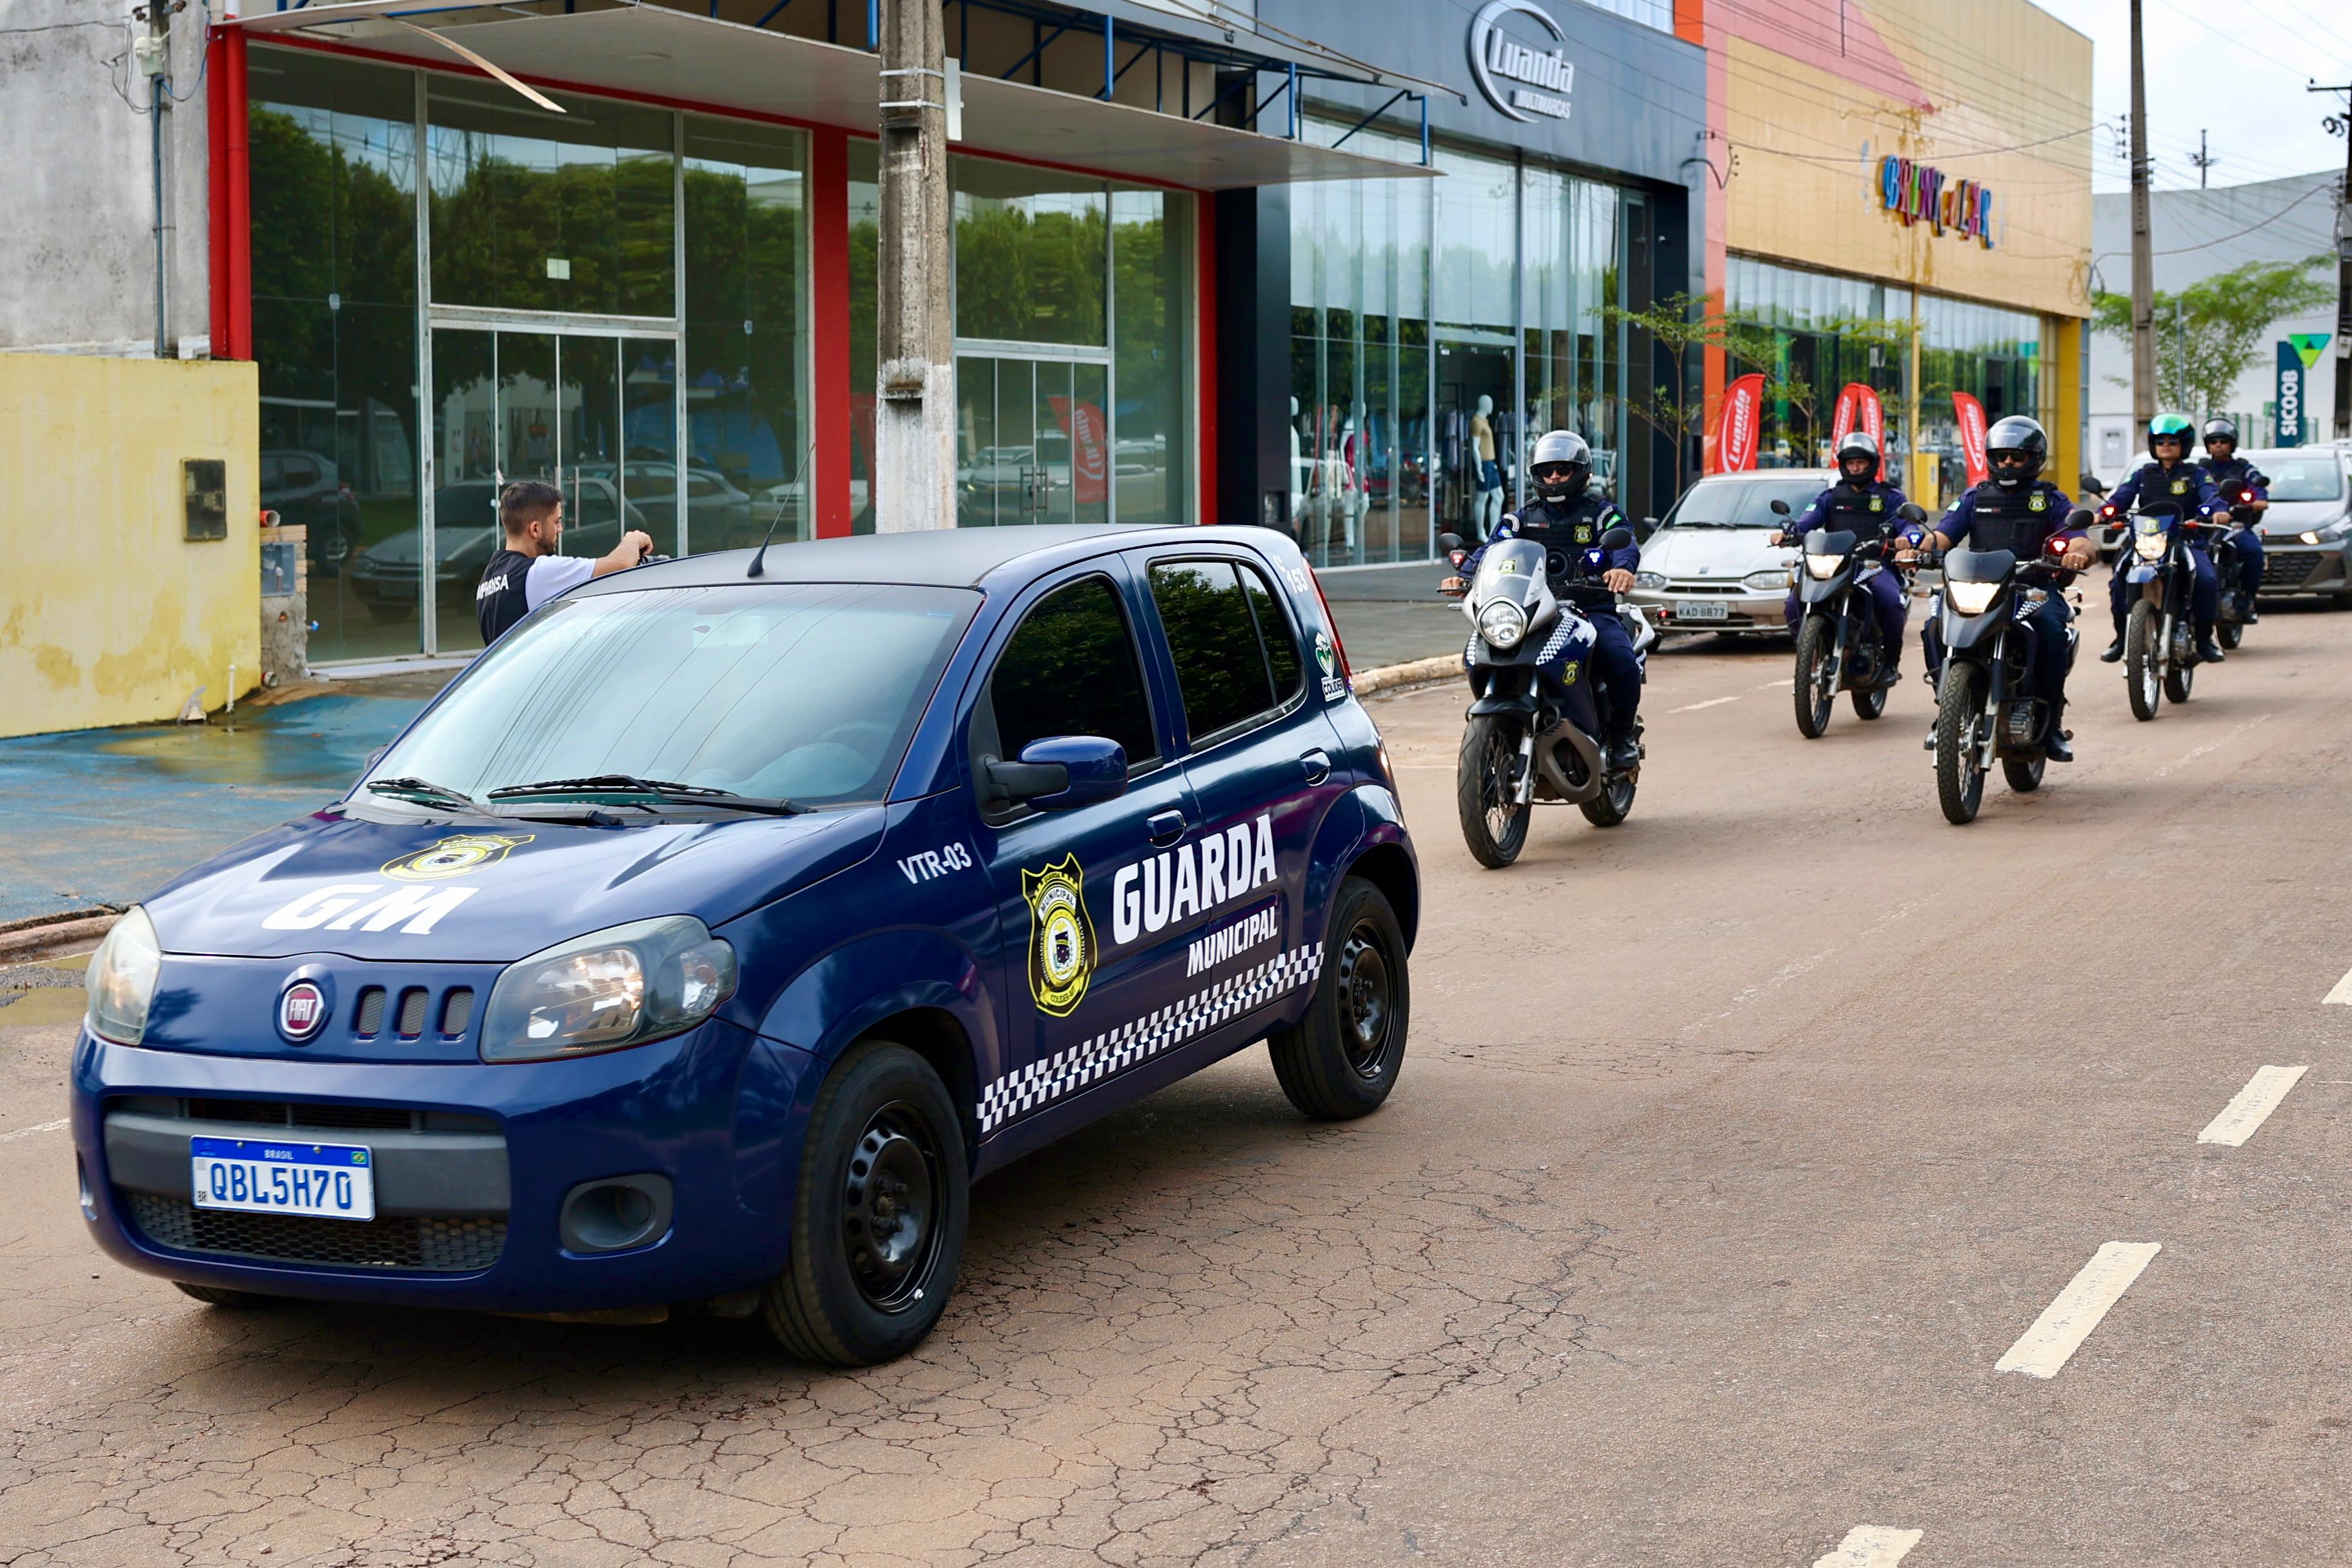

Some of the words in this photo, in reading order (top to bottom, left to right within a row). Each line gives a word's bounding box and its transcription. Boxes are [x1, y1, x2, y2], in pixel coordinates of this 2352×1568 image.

[1488, 27, 1574, 94] Luanda
[1513, 90, 1571, 119] MULTIMARCAS
[1728, 388, 1747, 465] Luanda
[2280, 369, 2298, 436] SICOOB
[1286, 568, 1308, 593] 153
[1679, 608, 1698, 617] KAD
[896, 842, 972, 884] VTR-03
[1113, 813, 1277, 945] GUARDA
[261, 884, 480, 935] GM
[1040, 889, 1074, 913] MUNICIPAL
[1076, 916, 1086, 967] PREVENTIVO
[1186, 906, 1278, 978] MUNICIPAL
[288, 998, 316, 1022] FIAT
[264, 1149, 294, 1160] BRASIL
[210, 1162, 352, 1210] QBL5H70
